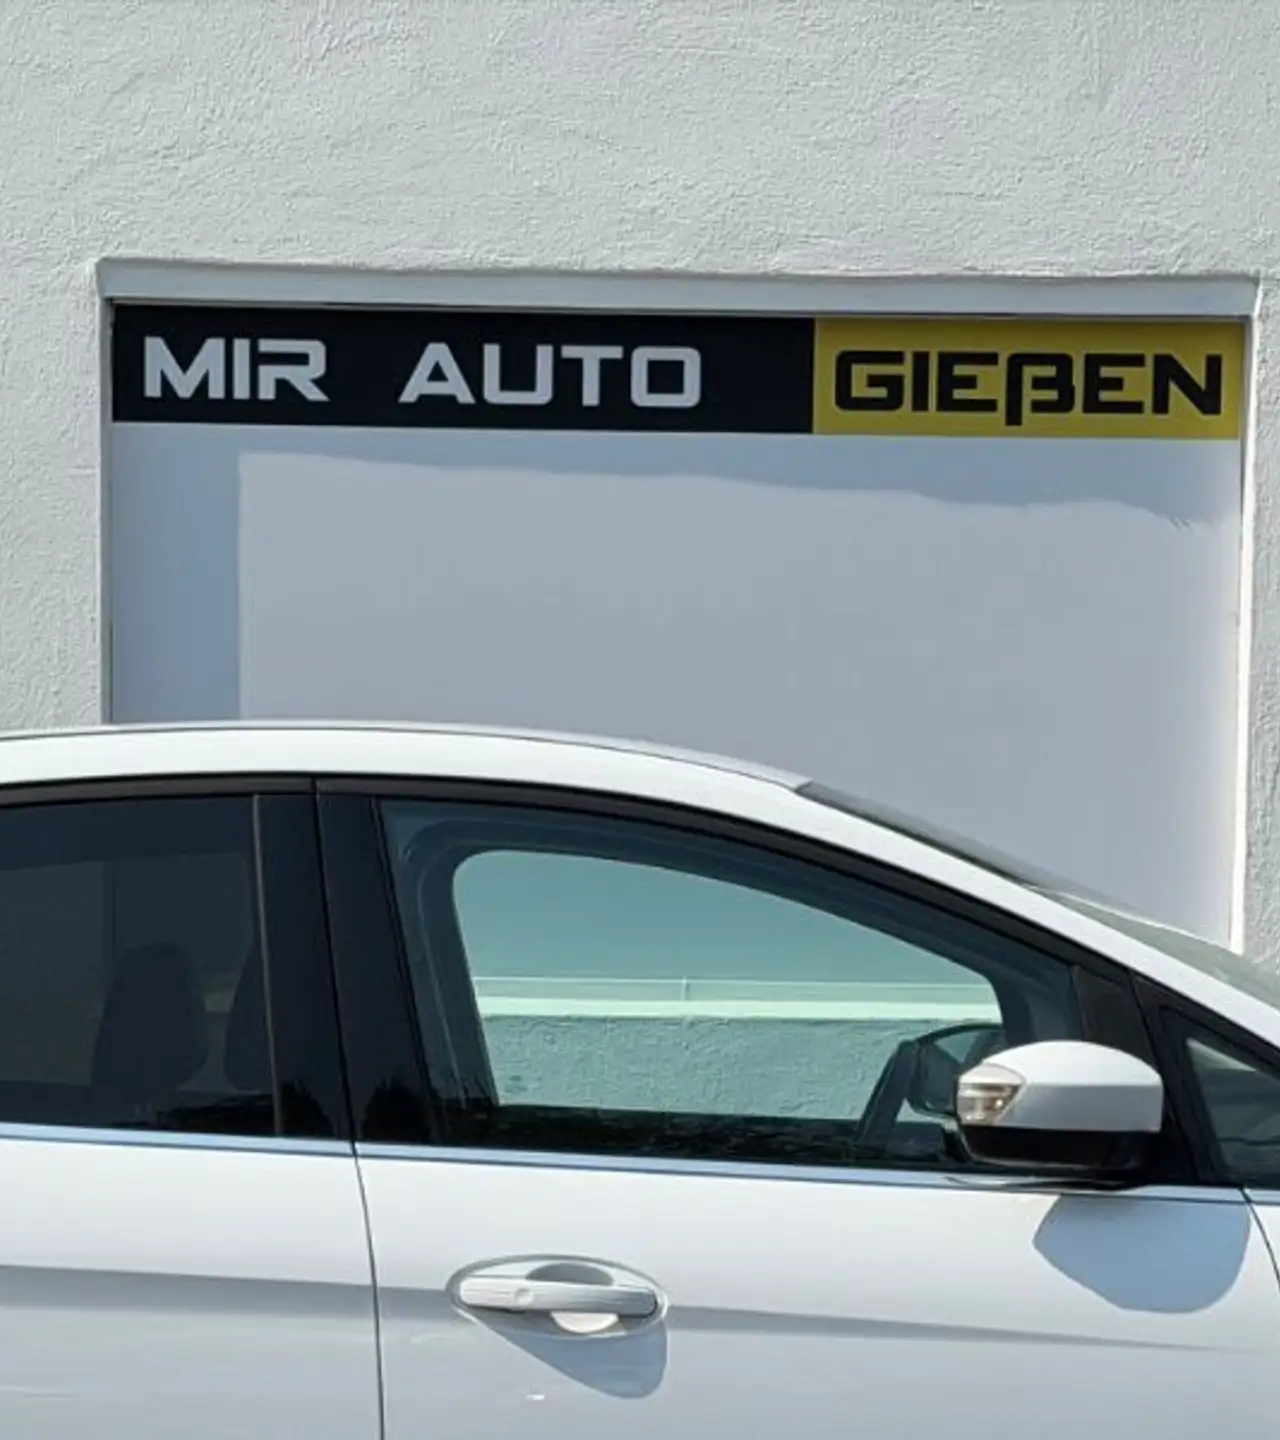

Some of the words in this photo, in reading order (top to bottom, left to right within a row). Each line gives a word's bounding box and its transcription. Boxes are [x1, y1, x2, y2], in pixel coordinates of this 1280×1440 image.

[143, 335, 331, 403] MIR
[397, 341, 702, 409] AUTO
[834, 349, 1223, 426] GIEßEN
